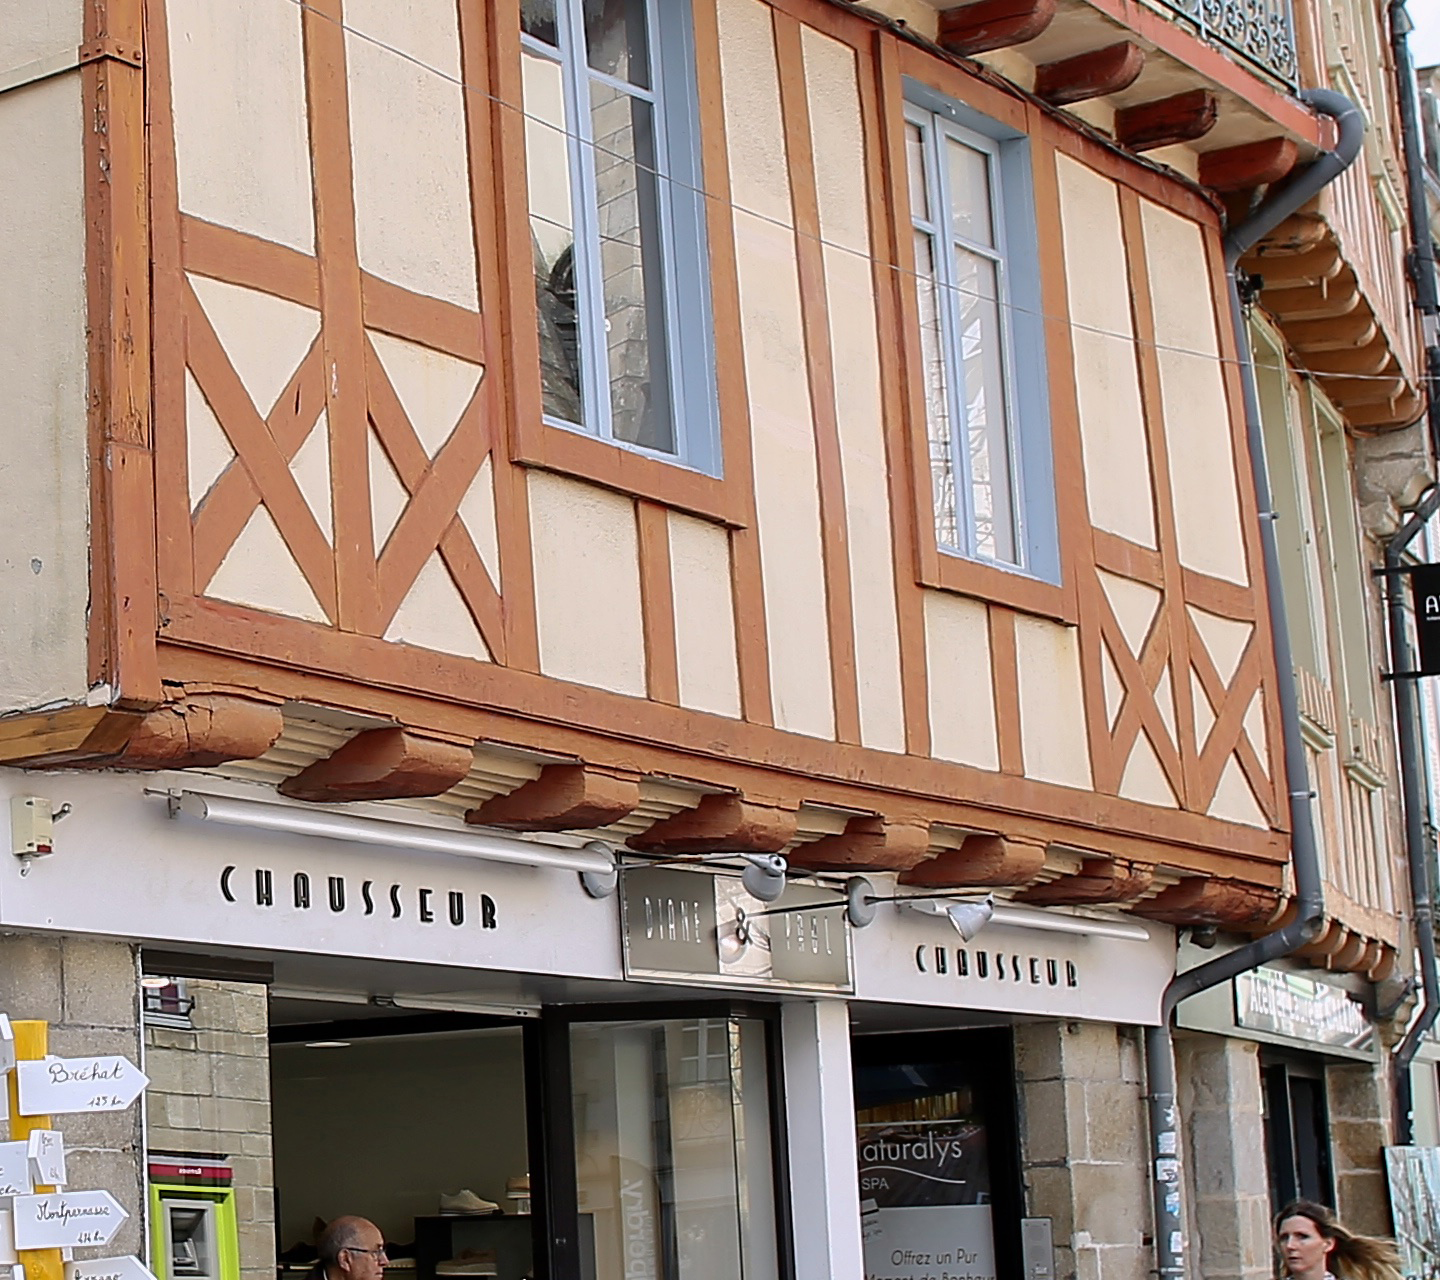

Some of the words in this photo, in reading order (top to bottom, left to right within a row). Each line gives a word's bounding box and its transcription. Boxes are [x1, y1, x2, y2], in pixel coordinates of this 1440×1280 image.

[220, 865, 497, 929] CHAUSSEUR
[916, 945, 1077, 987] CHAUSSEUR
[48, 1061, 124, 1084] Bréhat
[858, 1131, 962, 1167] aturalys
[861, 1178, 890, 1190] SPA
[891, 1250, 931, 1266] Offrez
[937, 1253, 952, 1265] un
[957, 1248, 978, 1265] Pur
